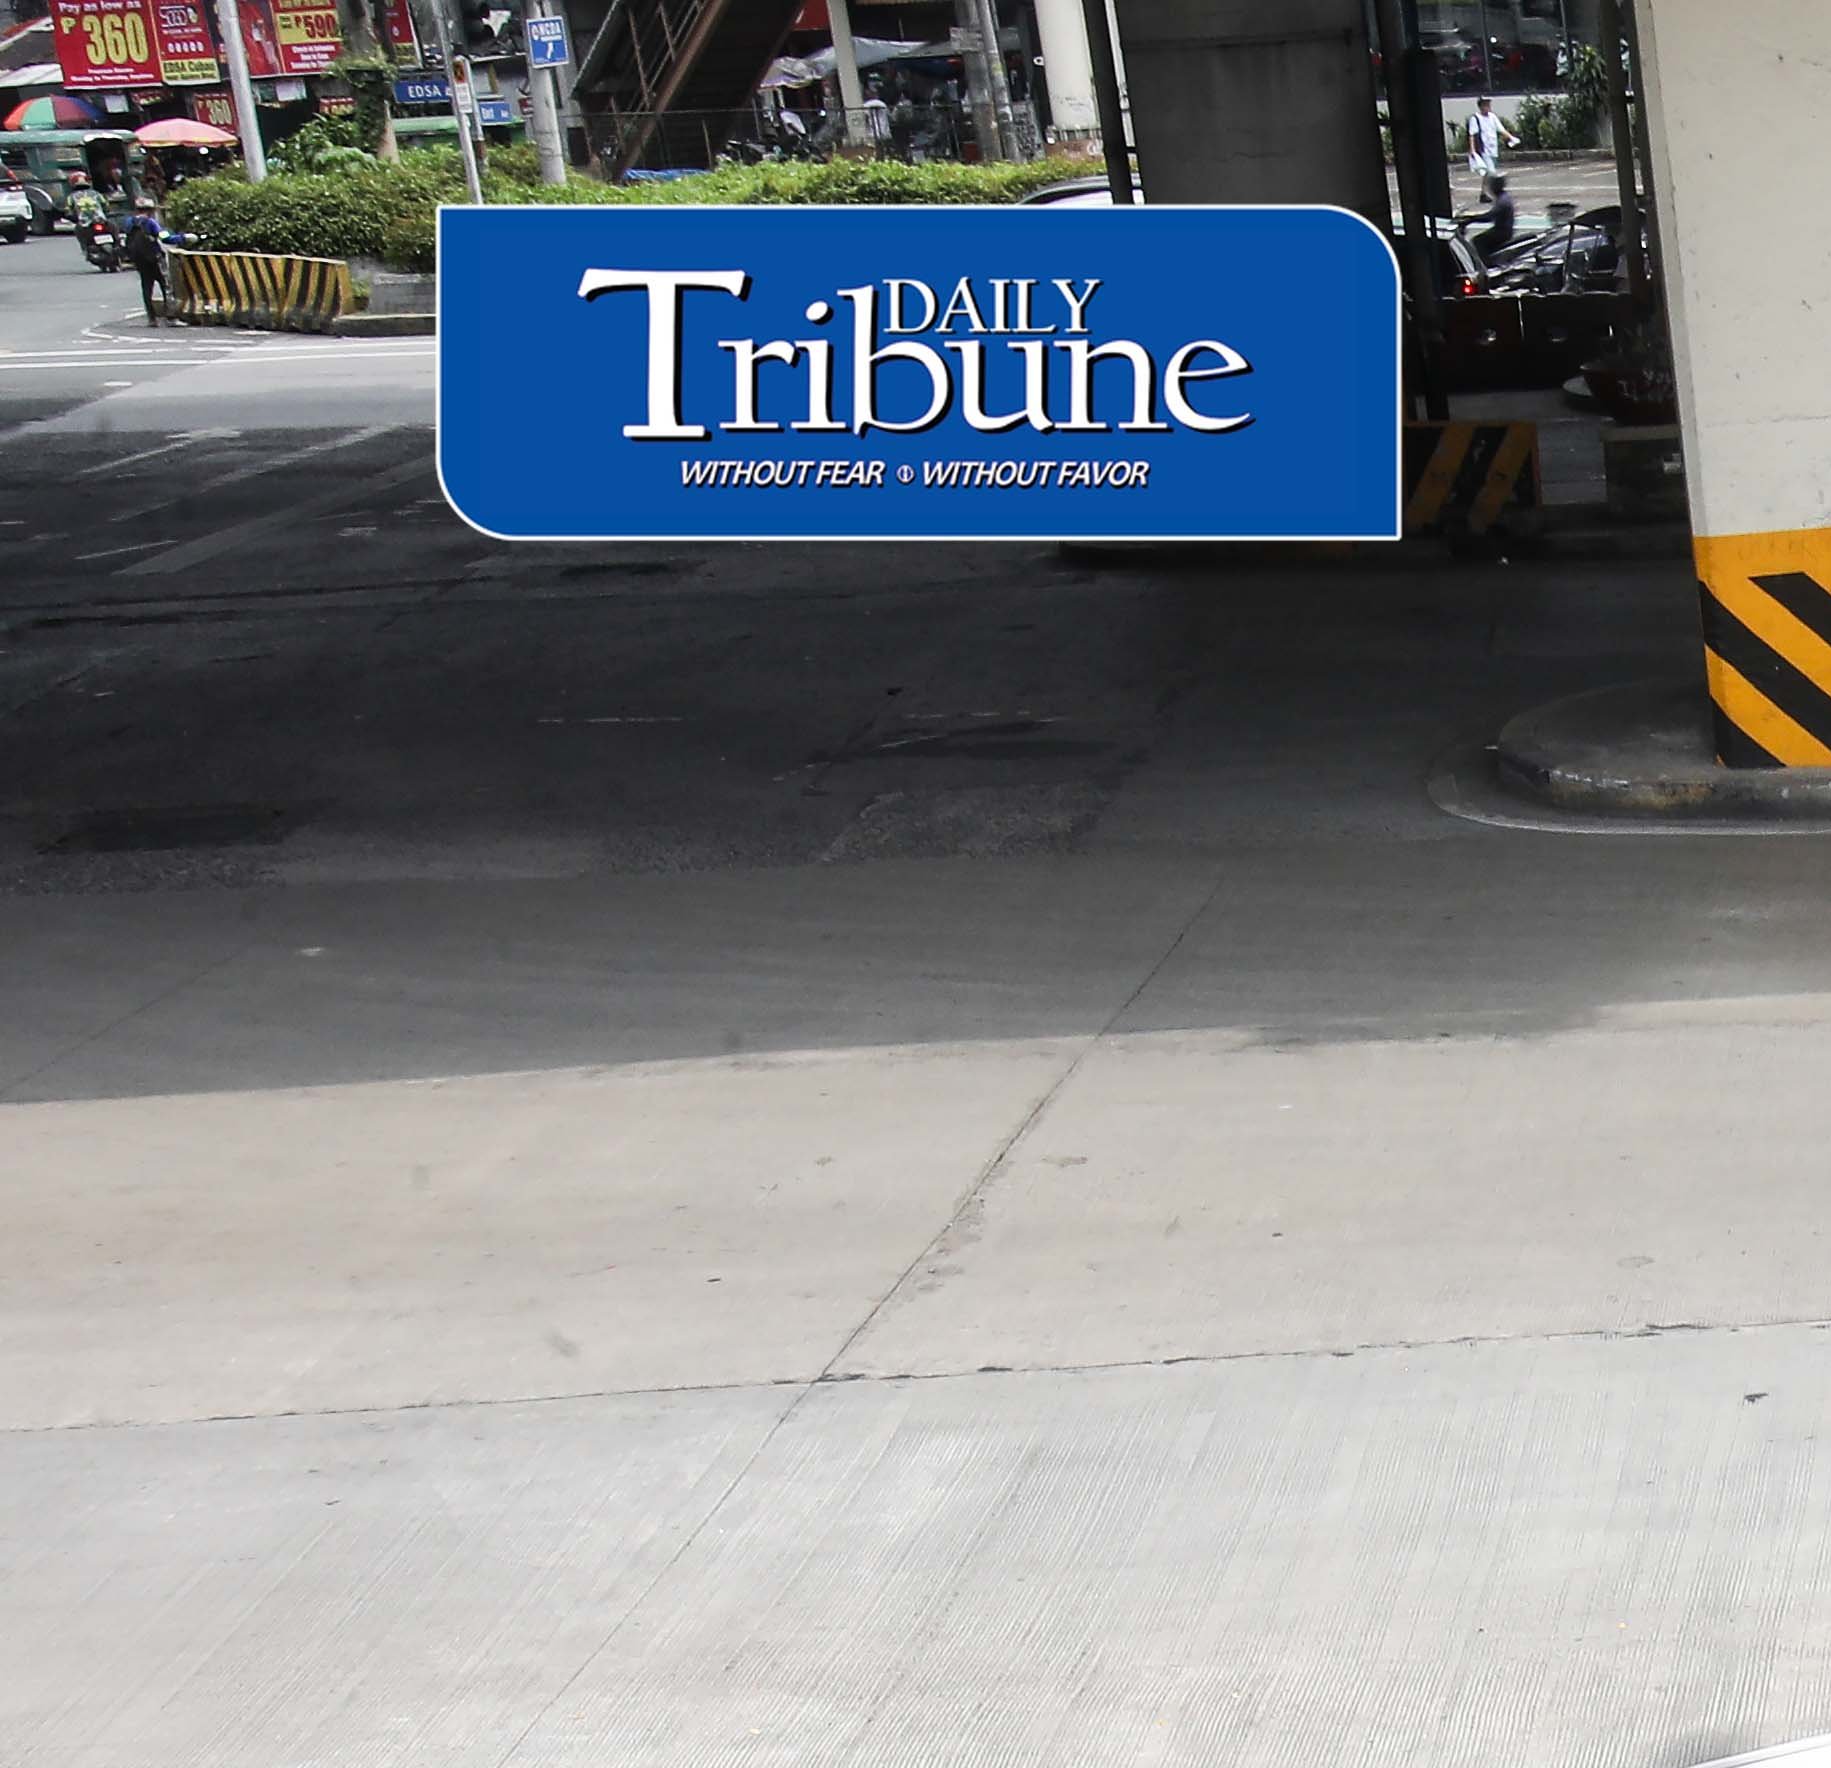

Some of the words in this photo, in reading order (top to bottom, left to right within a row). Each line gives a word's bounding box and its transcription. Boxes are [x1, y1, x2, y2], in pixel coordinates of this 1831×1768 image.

[58, 2, 81, 14] Pay
[100, 0, 123, 10] low
[82, 12, 149, 65] 360
[407, 84, 442, 98] EDSA
